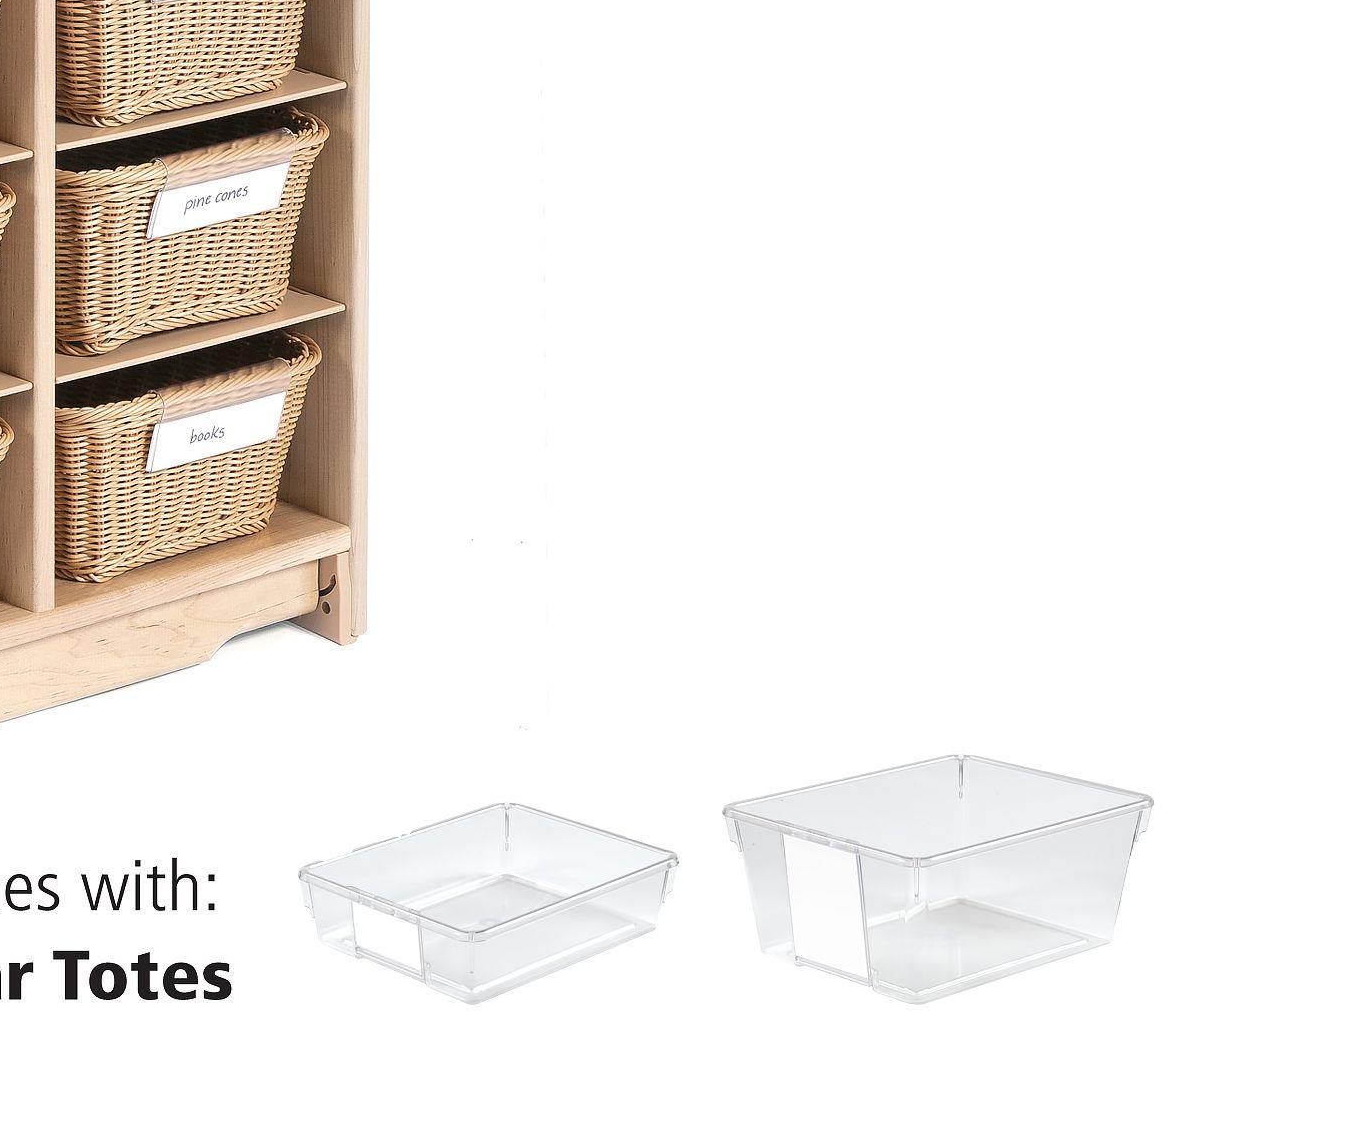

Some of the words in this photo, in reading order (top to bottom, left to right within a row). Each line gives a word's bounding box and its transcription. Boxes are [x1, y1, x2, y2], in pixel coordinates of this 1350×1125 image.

[183, 195, 211, 215] pine
[215, 185, 249, 203] cones
[190, 426, 225, 444] books
